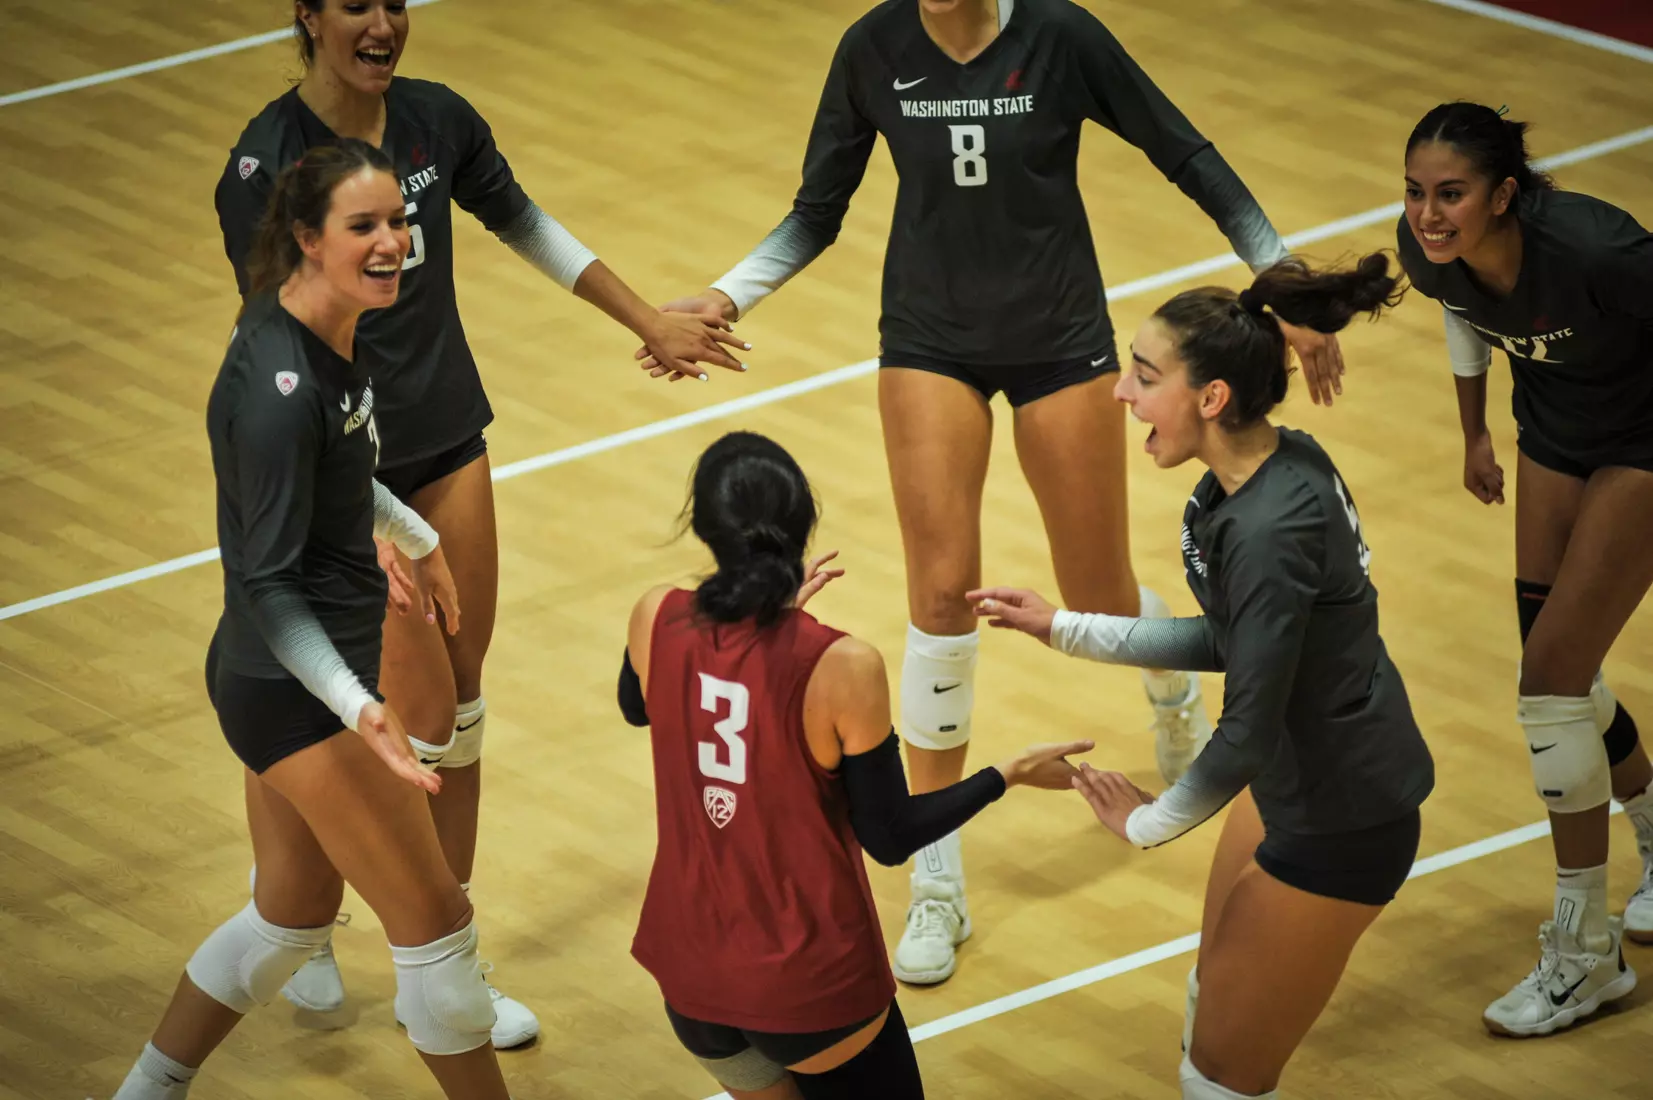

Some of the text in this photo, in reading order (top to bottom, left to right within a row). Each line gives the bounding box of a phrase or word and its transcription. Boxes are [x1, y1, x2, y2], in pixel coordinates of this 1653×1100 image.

[900, 95, 1034, 117] WASHINGTON STATE
[947, 124, 988, 187] 8
[697, 672, 750, 785] 3
[712, 804, 729, 819] 12
